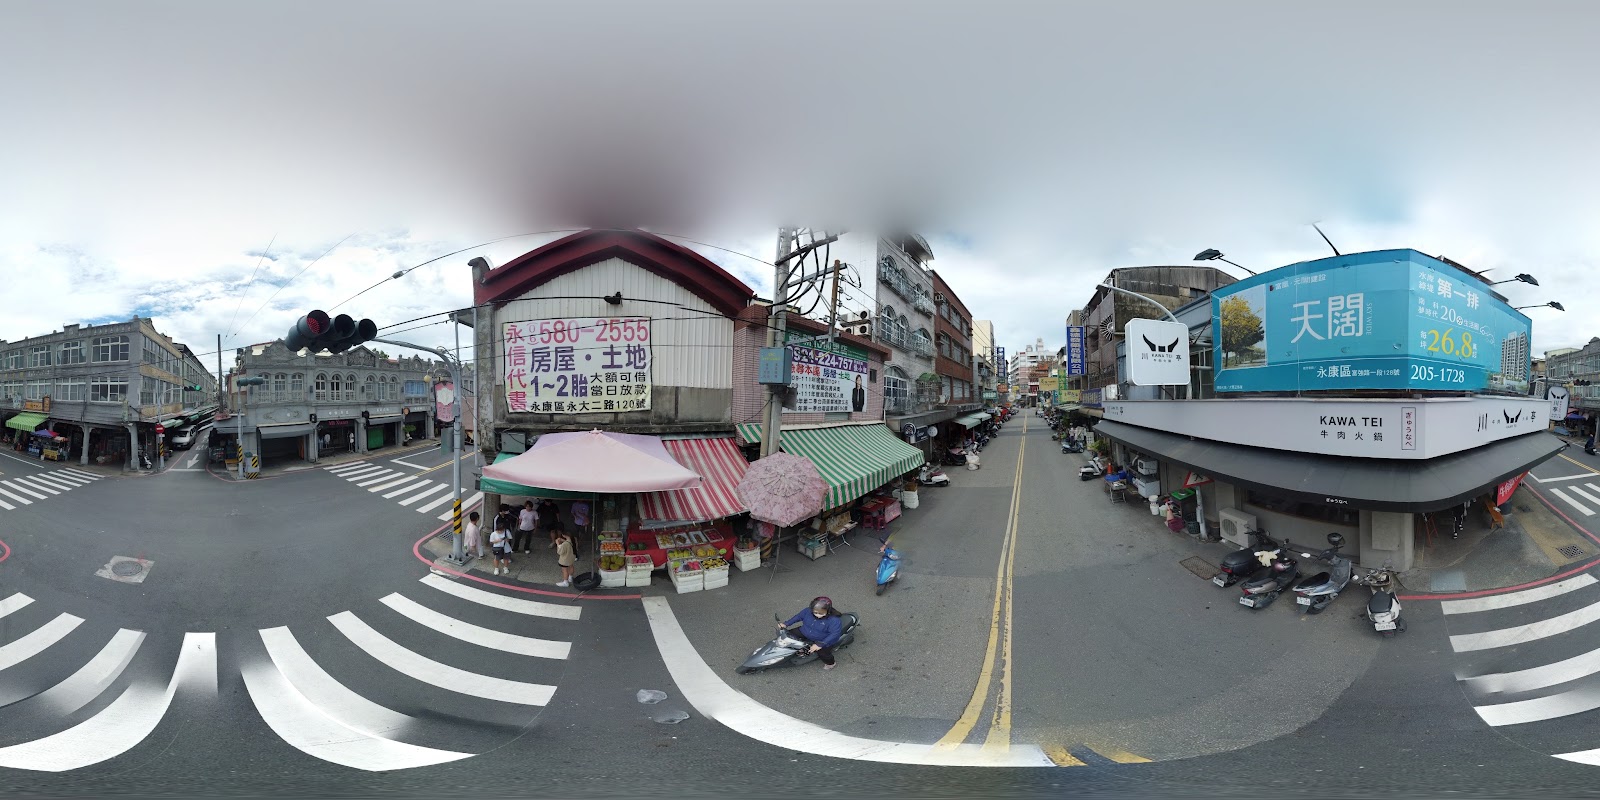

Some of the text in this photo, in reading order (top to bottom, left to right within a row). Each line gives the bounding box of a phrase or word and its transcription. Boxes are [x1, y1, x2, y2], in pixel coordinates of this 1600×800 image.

[1437, 278, 1479, 310] 第一排
[1290, 292, 1365, 344] 天闊
[540, 318, 649, 344] 580-2555
[1427, 328, 1473, 357] 26.8
[506, 324, 527, 411] 永信代書
[590, 372, 647, 383] 大額可借
[1410, 364, 1465, 383] 205-1728
[530, 374, 588, 398] 1~2胎
[590, 384, 647, 396] 當日放款
[531, 398, 646, 412] 永康區永大二路120號
[1320, 415, 1382, 427] KAWA TEI
[1320, 429, 1383, 442] 牛肉火鍋
